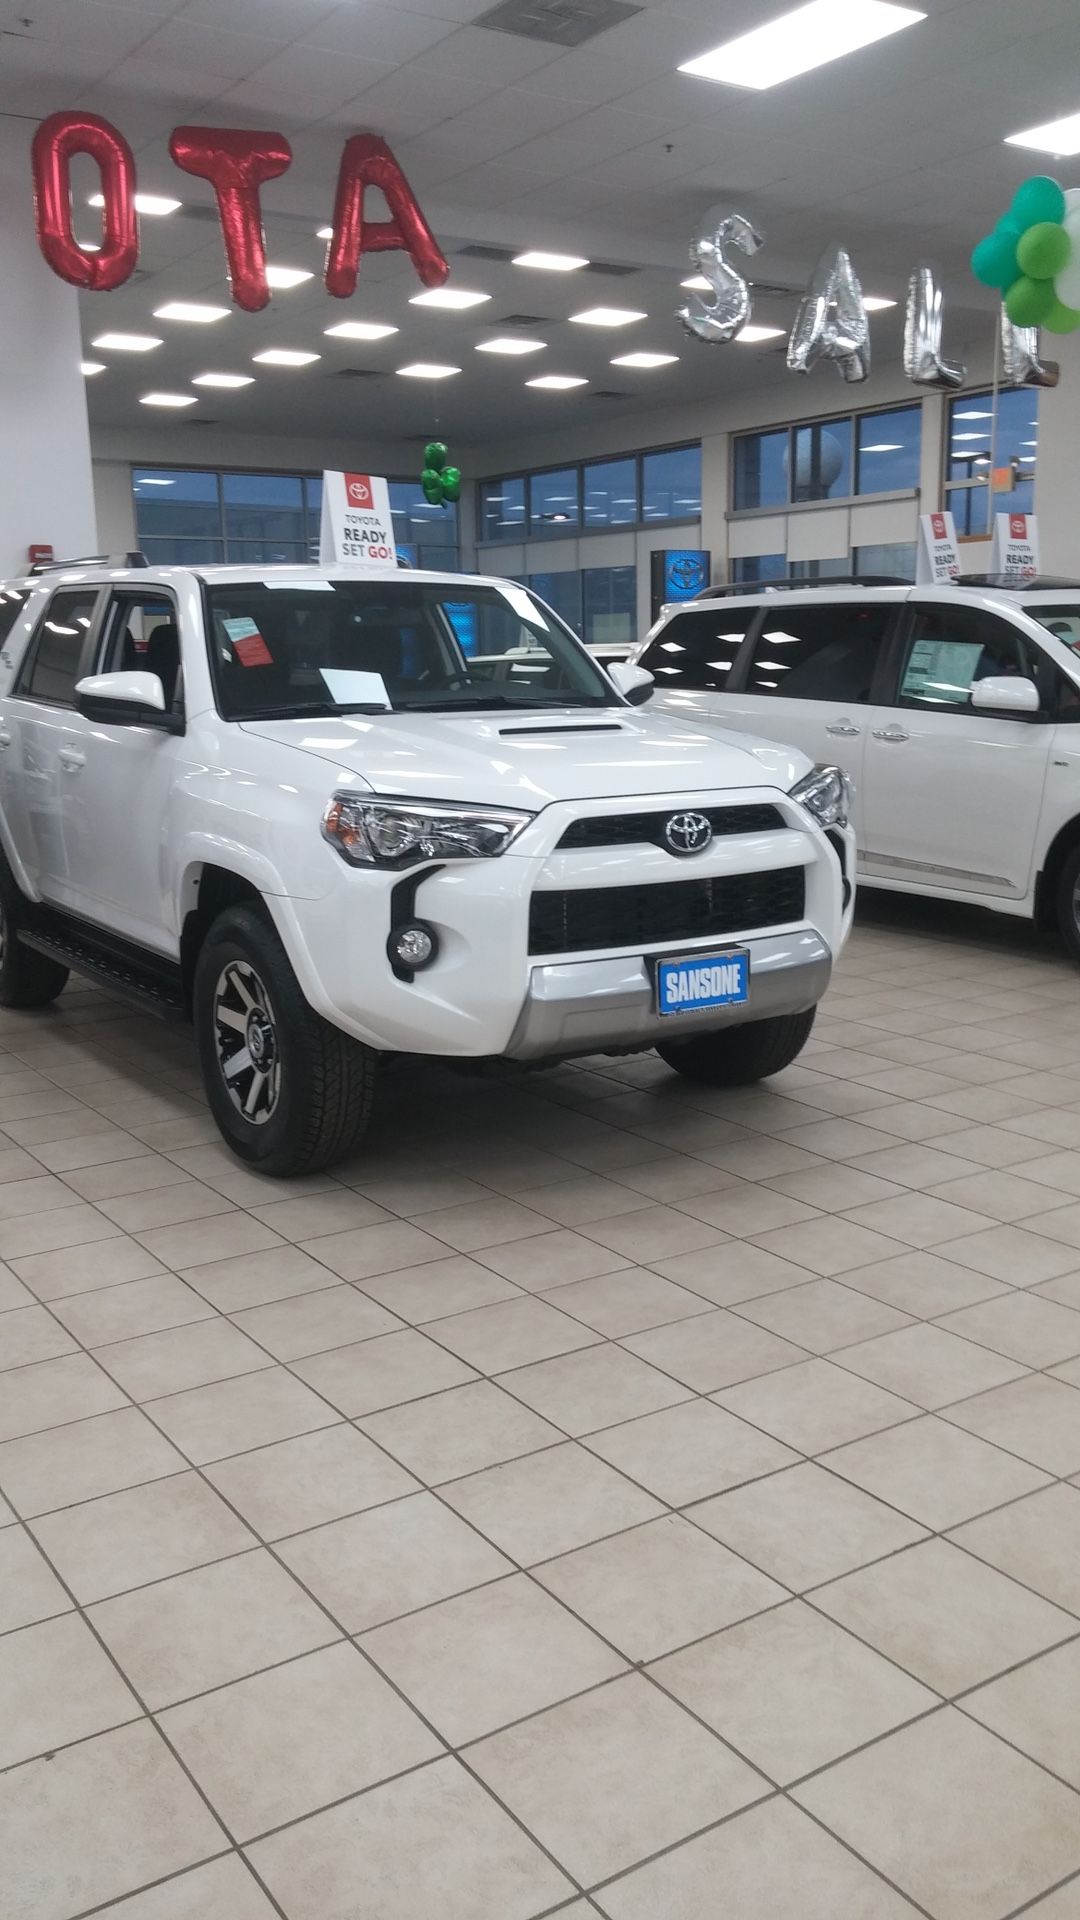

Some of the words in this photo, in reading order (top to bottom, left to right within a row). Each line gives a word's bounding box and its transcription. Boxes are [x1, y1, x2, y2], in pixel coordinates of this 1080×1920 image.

[31, 110, 450, 312] OTA
[345, 514, 381, 526] TOYOTA
[344, 528, 387, 544] READY
[342, 543, 365, 557] SET
[368, 546, 393, 560] GO!
[1007, 544, 1032, 552] TOYOTA
[935, 554, 956, 566] READY
[1006, 554, 1035, 565] READY
[936, 567, 946, 577] SET
[1005, 566, 1019, 576] SET
[666, 963, 741, 1004] SANSONE
